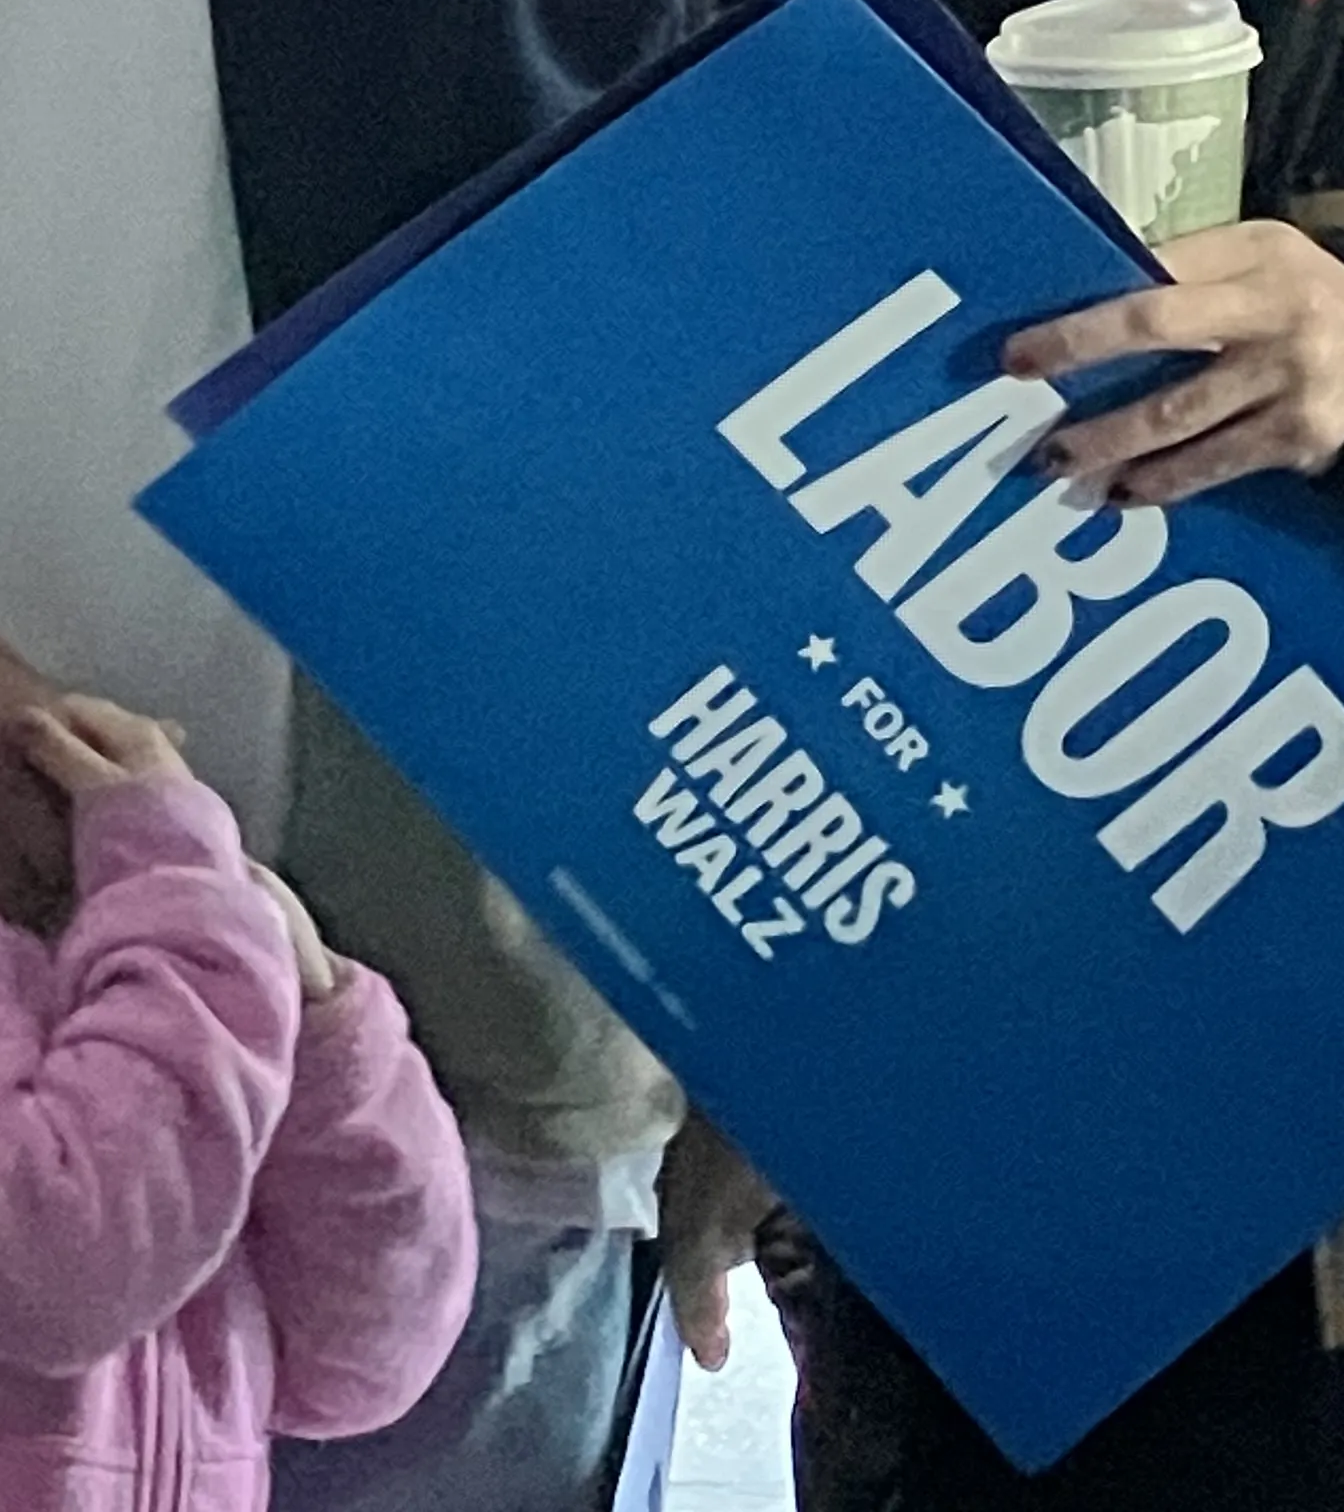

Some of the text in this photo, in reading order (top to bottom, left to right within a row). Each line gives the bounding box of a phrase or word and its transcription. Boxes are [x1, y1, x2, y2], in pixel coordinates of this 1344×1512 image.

[648, 664, 916, 945] HARRIS
[841, 676, 928, 773] FOR
[633, 767, 806, 961] WALZ
